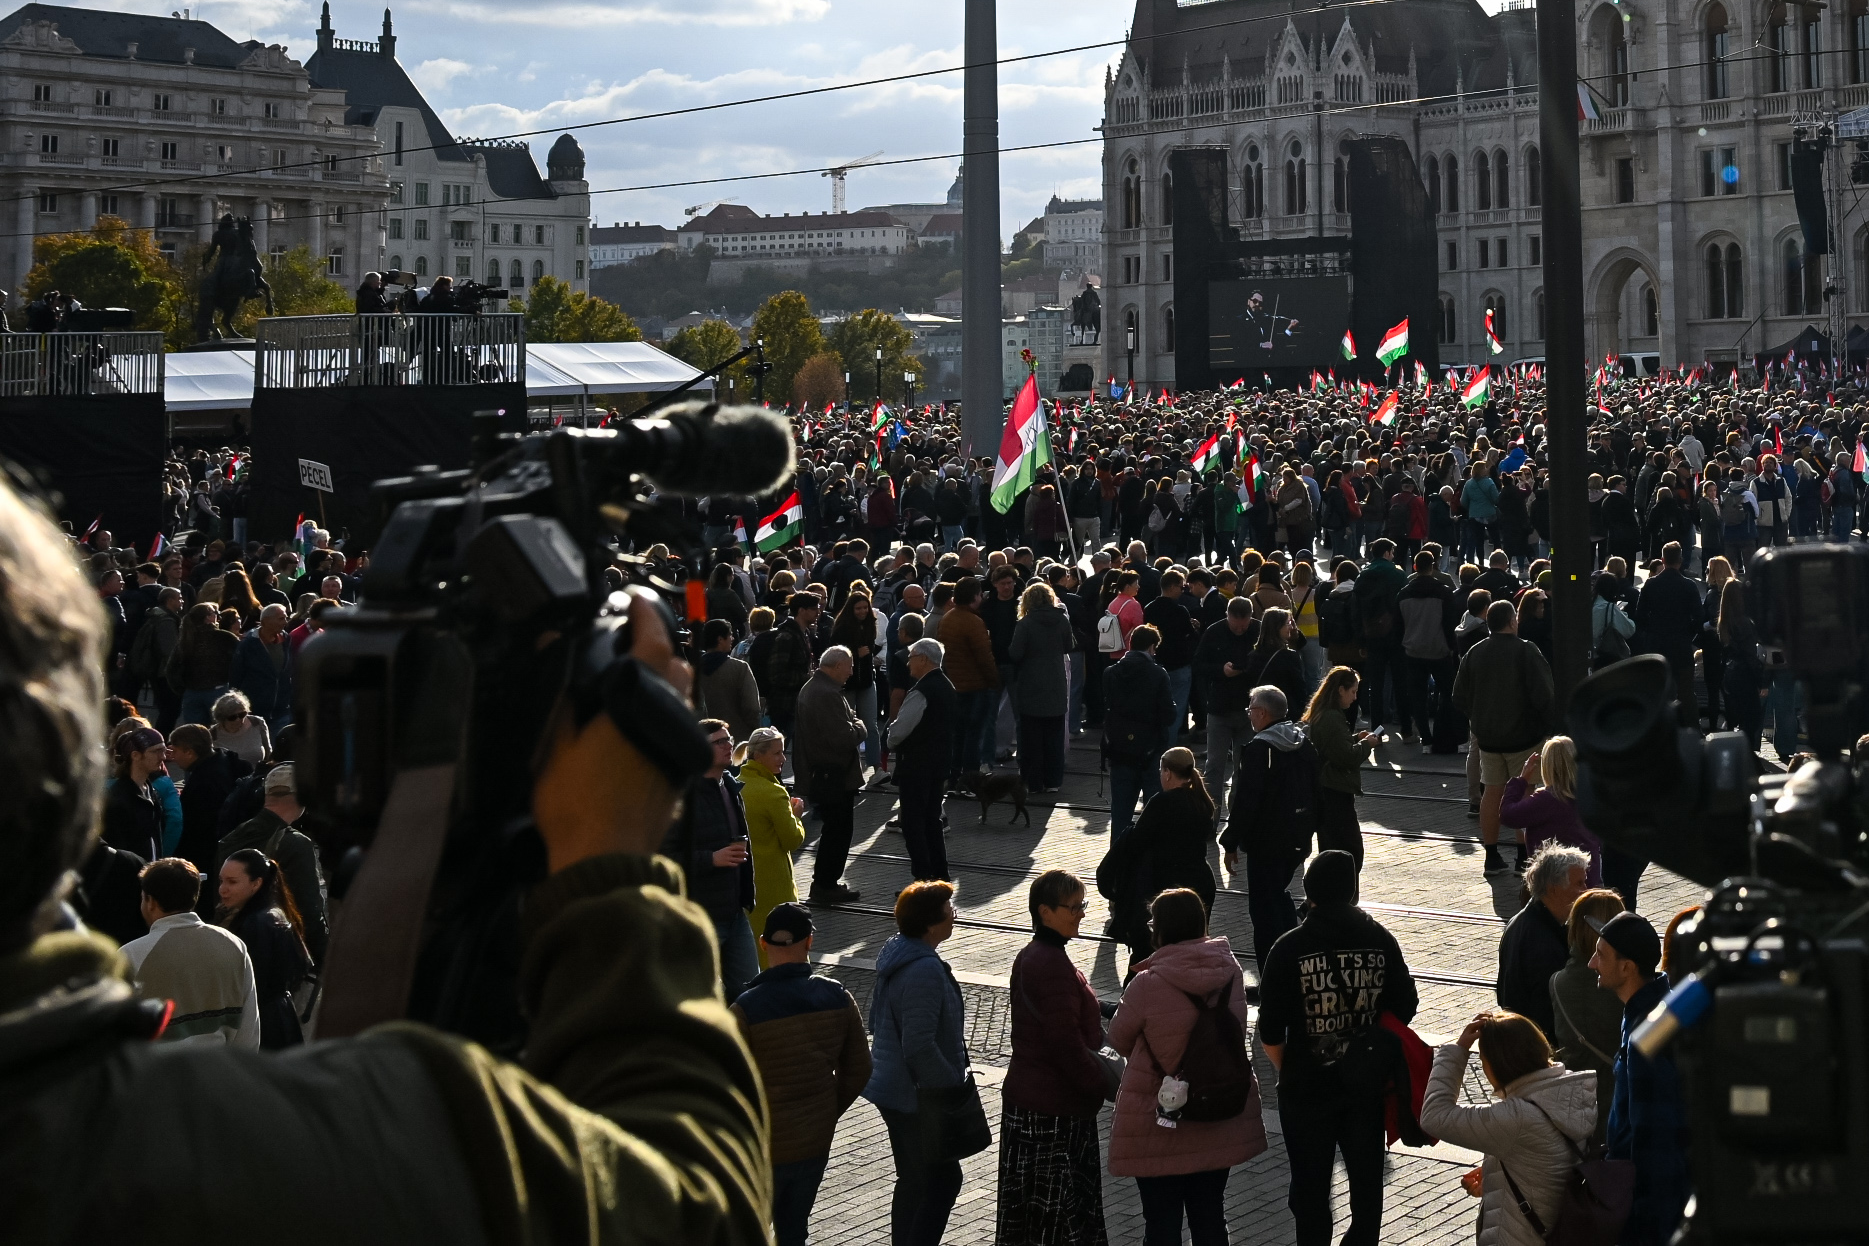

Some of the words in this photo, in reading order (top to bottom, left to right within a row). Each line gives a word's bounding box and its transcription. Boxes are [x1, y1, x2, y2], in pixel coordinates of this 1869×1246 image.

[301, 462, 331, 489] PÉCEL
[1299, 953, 1362, 975] WHT'S
[1367, 953, 1386, 968] SO
[1300, 969, 1386, 994] FUCKING
